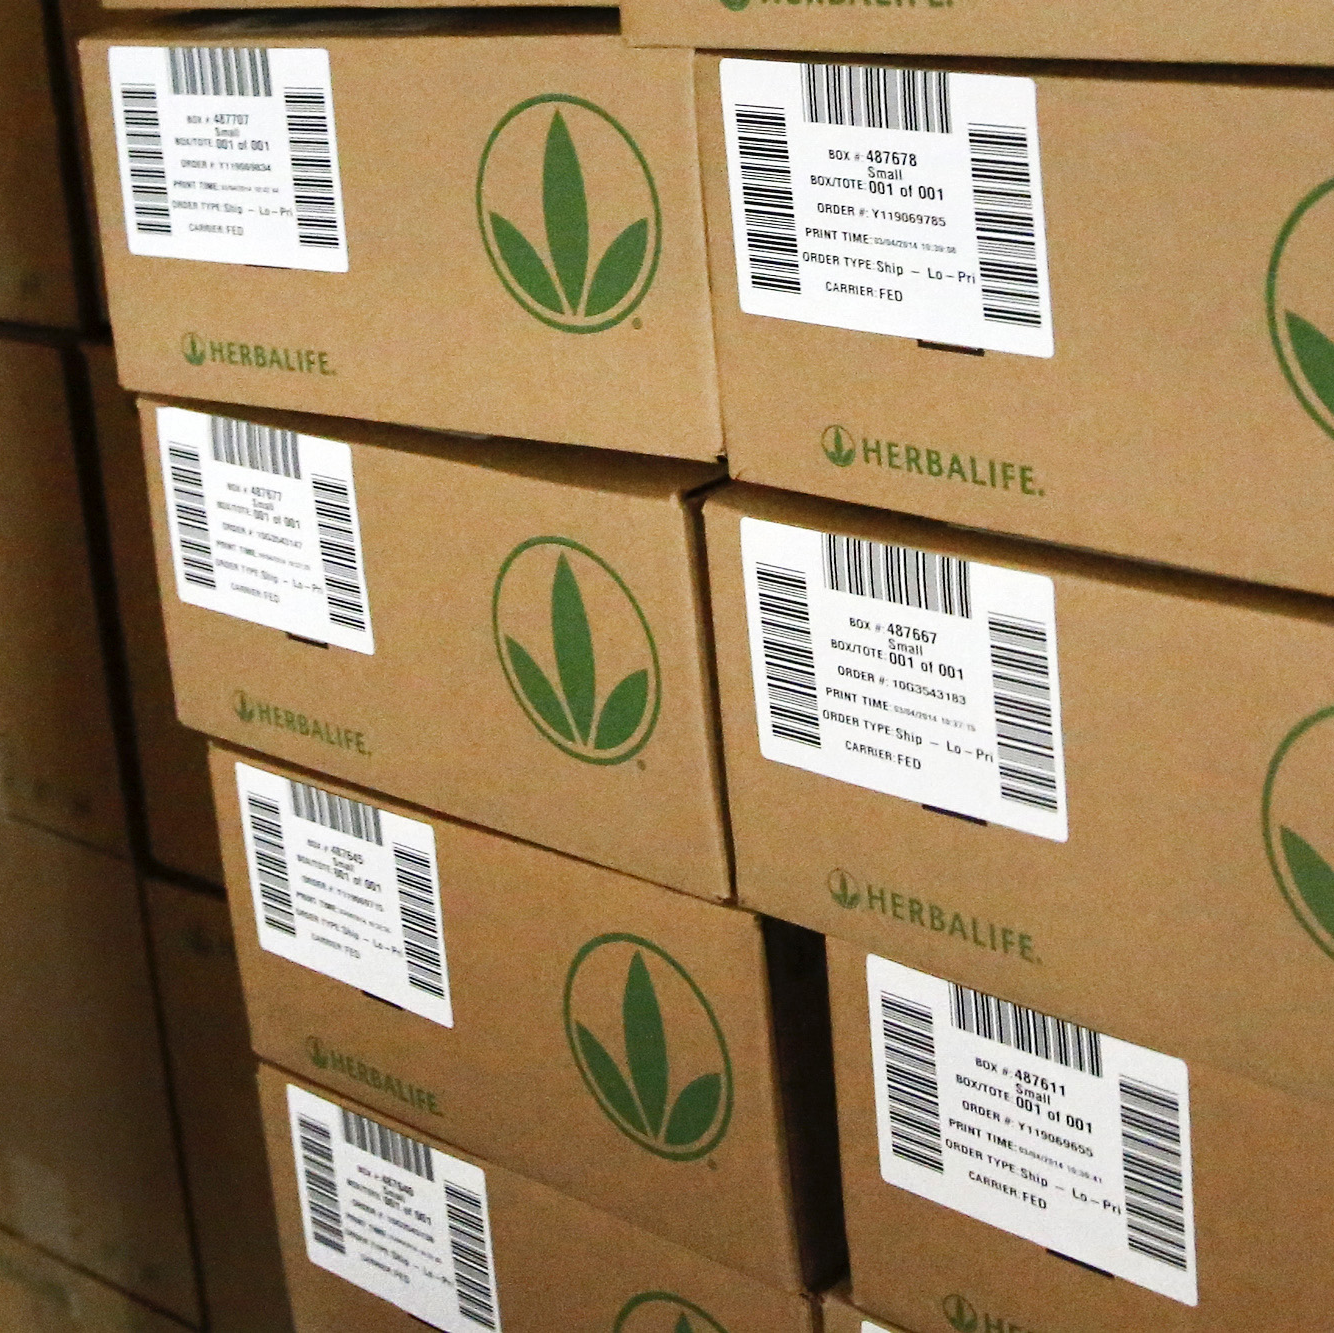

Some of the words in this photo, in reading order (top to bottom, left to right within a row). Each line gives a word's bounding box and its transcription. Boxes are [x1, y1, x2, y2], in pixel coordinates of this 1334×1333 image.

[829, 150, 849, 161] BOX
[866, 150, 917, 166] 487678
[868, 166, 902, 180] Small
[869, 181, 893, 195] 001
[900, 186, 912, 197] of
[919, 186, 943, 200] 001
[817, 203, 854, 216] ORDER
[805, 228, 837, 240] PRINT
[803, 252, 839, 265] ORDER
[877, 261, 904, 276] Ship
[880, 288, 903, 302] FED
[849, 617, 871, 630] BOX
[887, 624, 937, 644] 487667
[888, 639, 923, 656] Small
[838, 666, 874, 683] ORDER
[889, 653, 914, 668] 001
[921, 661, 933, 673] of
[939, 664, 964, 680] 001
[825, 687, 857, 702] PRINT
[822, 709, 859, 727] ORDER
[895, 727, 922, 745] Ship
[898, 755, 921, 770] FED
[975, 1057, 997, 1073] BOX
[1015, 1069, 1066, 1097] 487611
[1016, 1084, 1051, 1104] Small
[962, 1101, 1000, 1122] ORDER
[1016, 1096, 1040, 1116] 001
[1048, 1111, 1060, 1123] of
[1067, 1115, 1092, 1134] 001
[949, 1118, 982, 1138] PRINT
[945, 1138, 983, 1161] ORDER
[1021, 1168, 1048, 1187] Ship
[1022, 1191, 1047, 1209] FED
